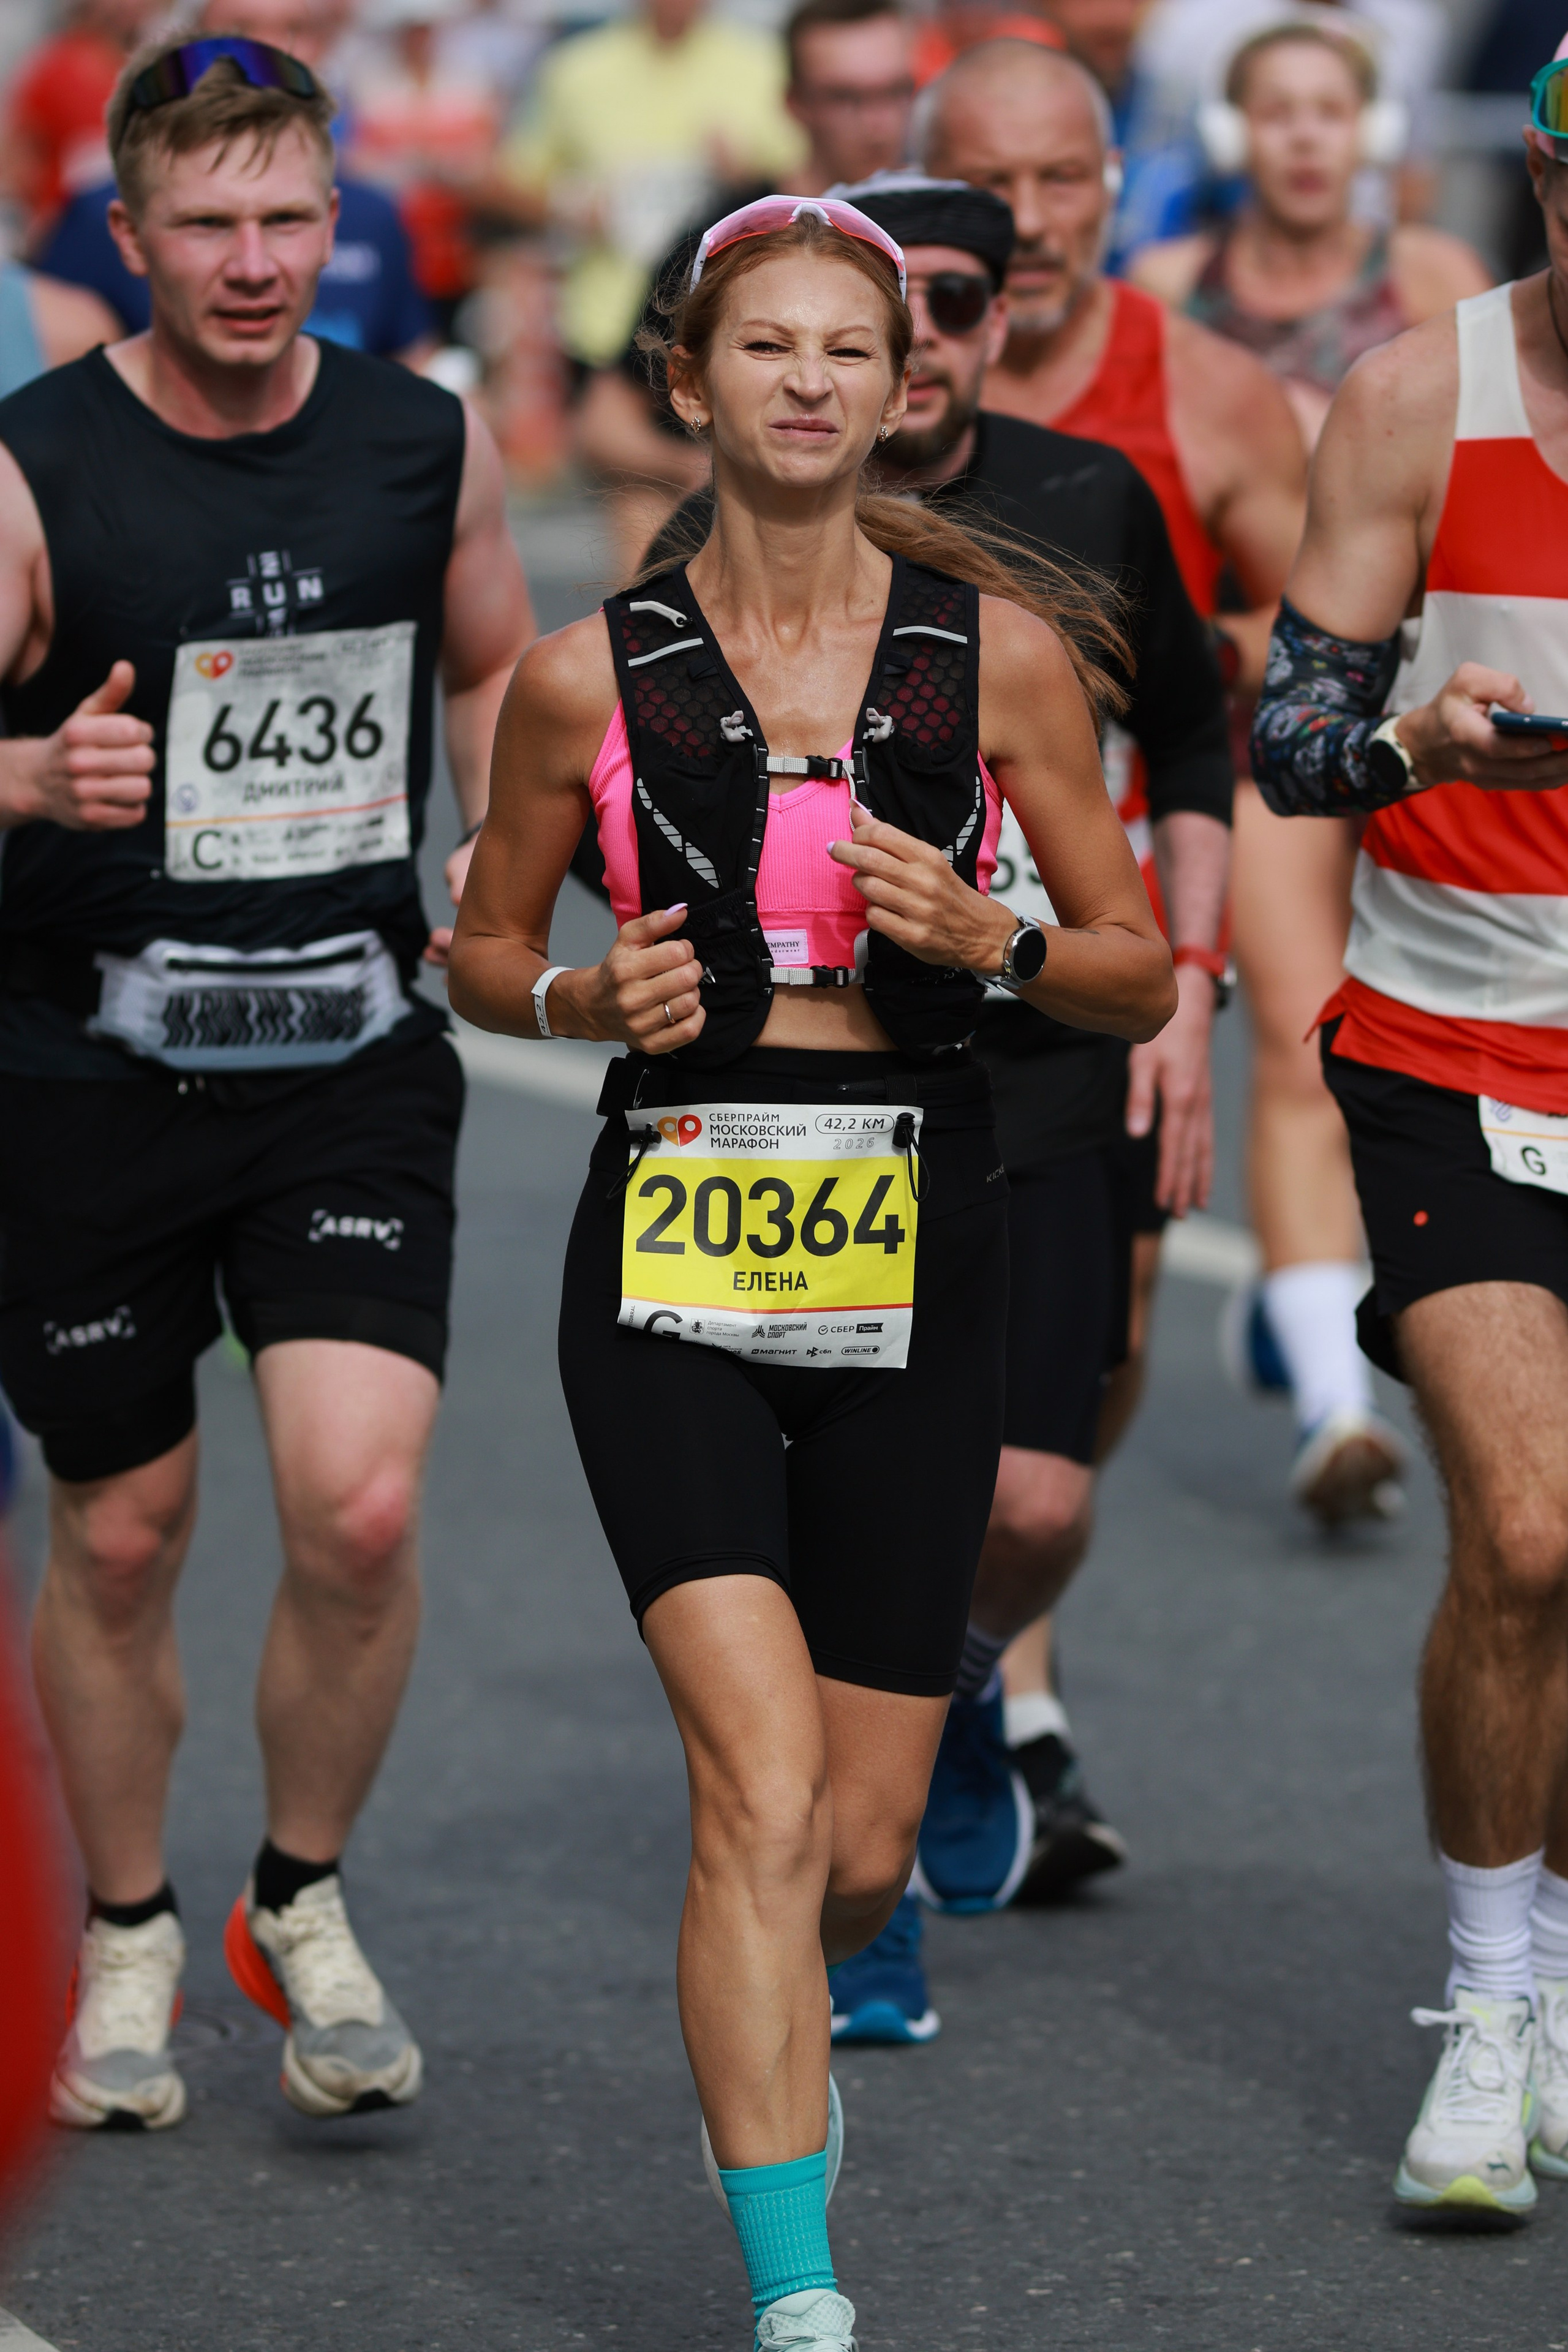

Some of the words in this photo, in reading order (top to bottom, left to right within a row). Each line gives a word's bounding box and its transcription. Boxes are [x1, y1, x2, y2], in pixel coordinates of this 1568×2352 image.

[203, 692, 383, 773] 6436
[243, 774, 345, 804] ДМИТРИЙ
[709, 1112, 779, 1122] СБЕРПРАЙМ
[710, 1123, 807, 1136] МОСКОВСКИЙ
[824, 1118, 857, 1131] 42,2
[862, 1118, 885, 1129] КМ
[710, 1137, 779, 1149] МАРАФОН
[833, 1137, 875, 1150] 2026
[1521, 1146, 1547, 1176] G
[636, 1174, 906, 1258] 20364
[733, 1270, 809, 1291] ЕЛЕНА
[769, 1322, 807, 1332] МОСКОВСКИЙ
